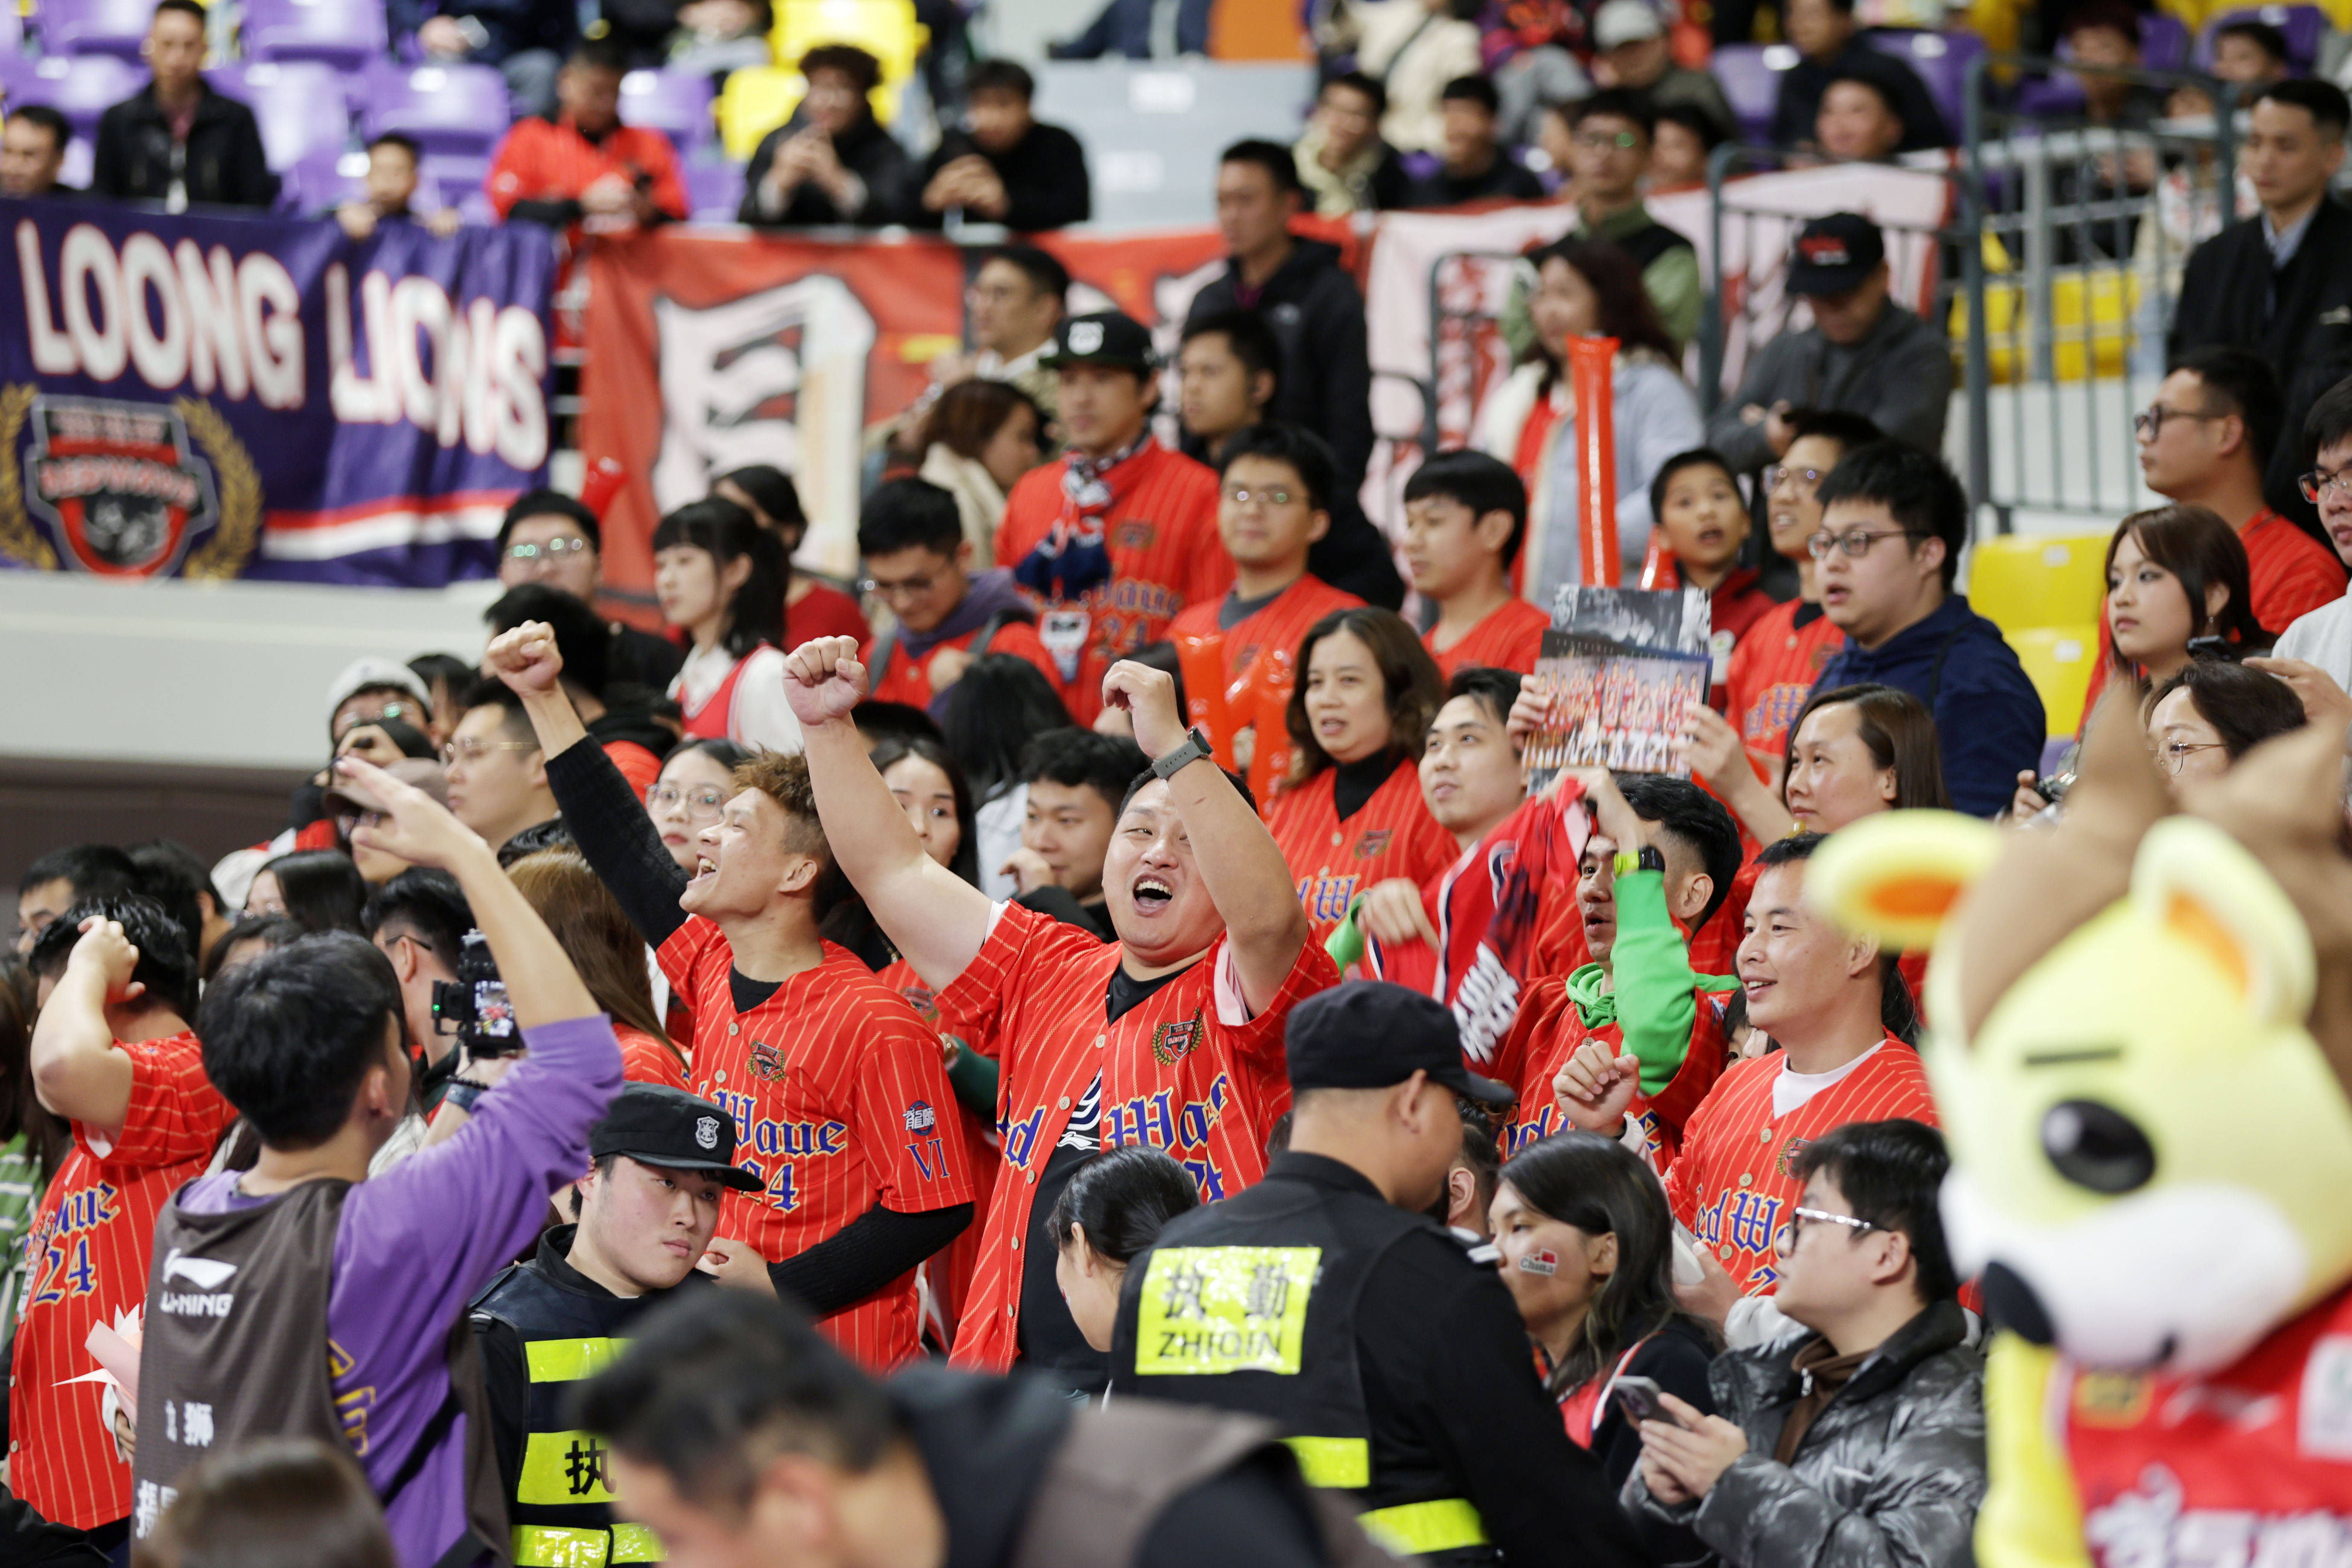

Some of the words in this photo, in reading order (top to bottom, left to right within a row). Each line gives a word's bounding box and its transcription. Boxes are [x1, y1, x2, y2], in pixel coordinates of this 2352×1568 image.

[16, 218, 305, 410] LOONG
[905, 1138, 951, 1182] VI
[32, 1235, 98, 1307] 24
[1520, 1257, 1553, 1273] China
[1163, 1263, 1289, 1319] 执勤
[1158, 1331, 1281, 1358] ZHIQIN
